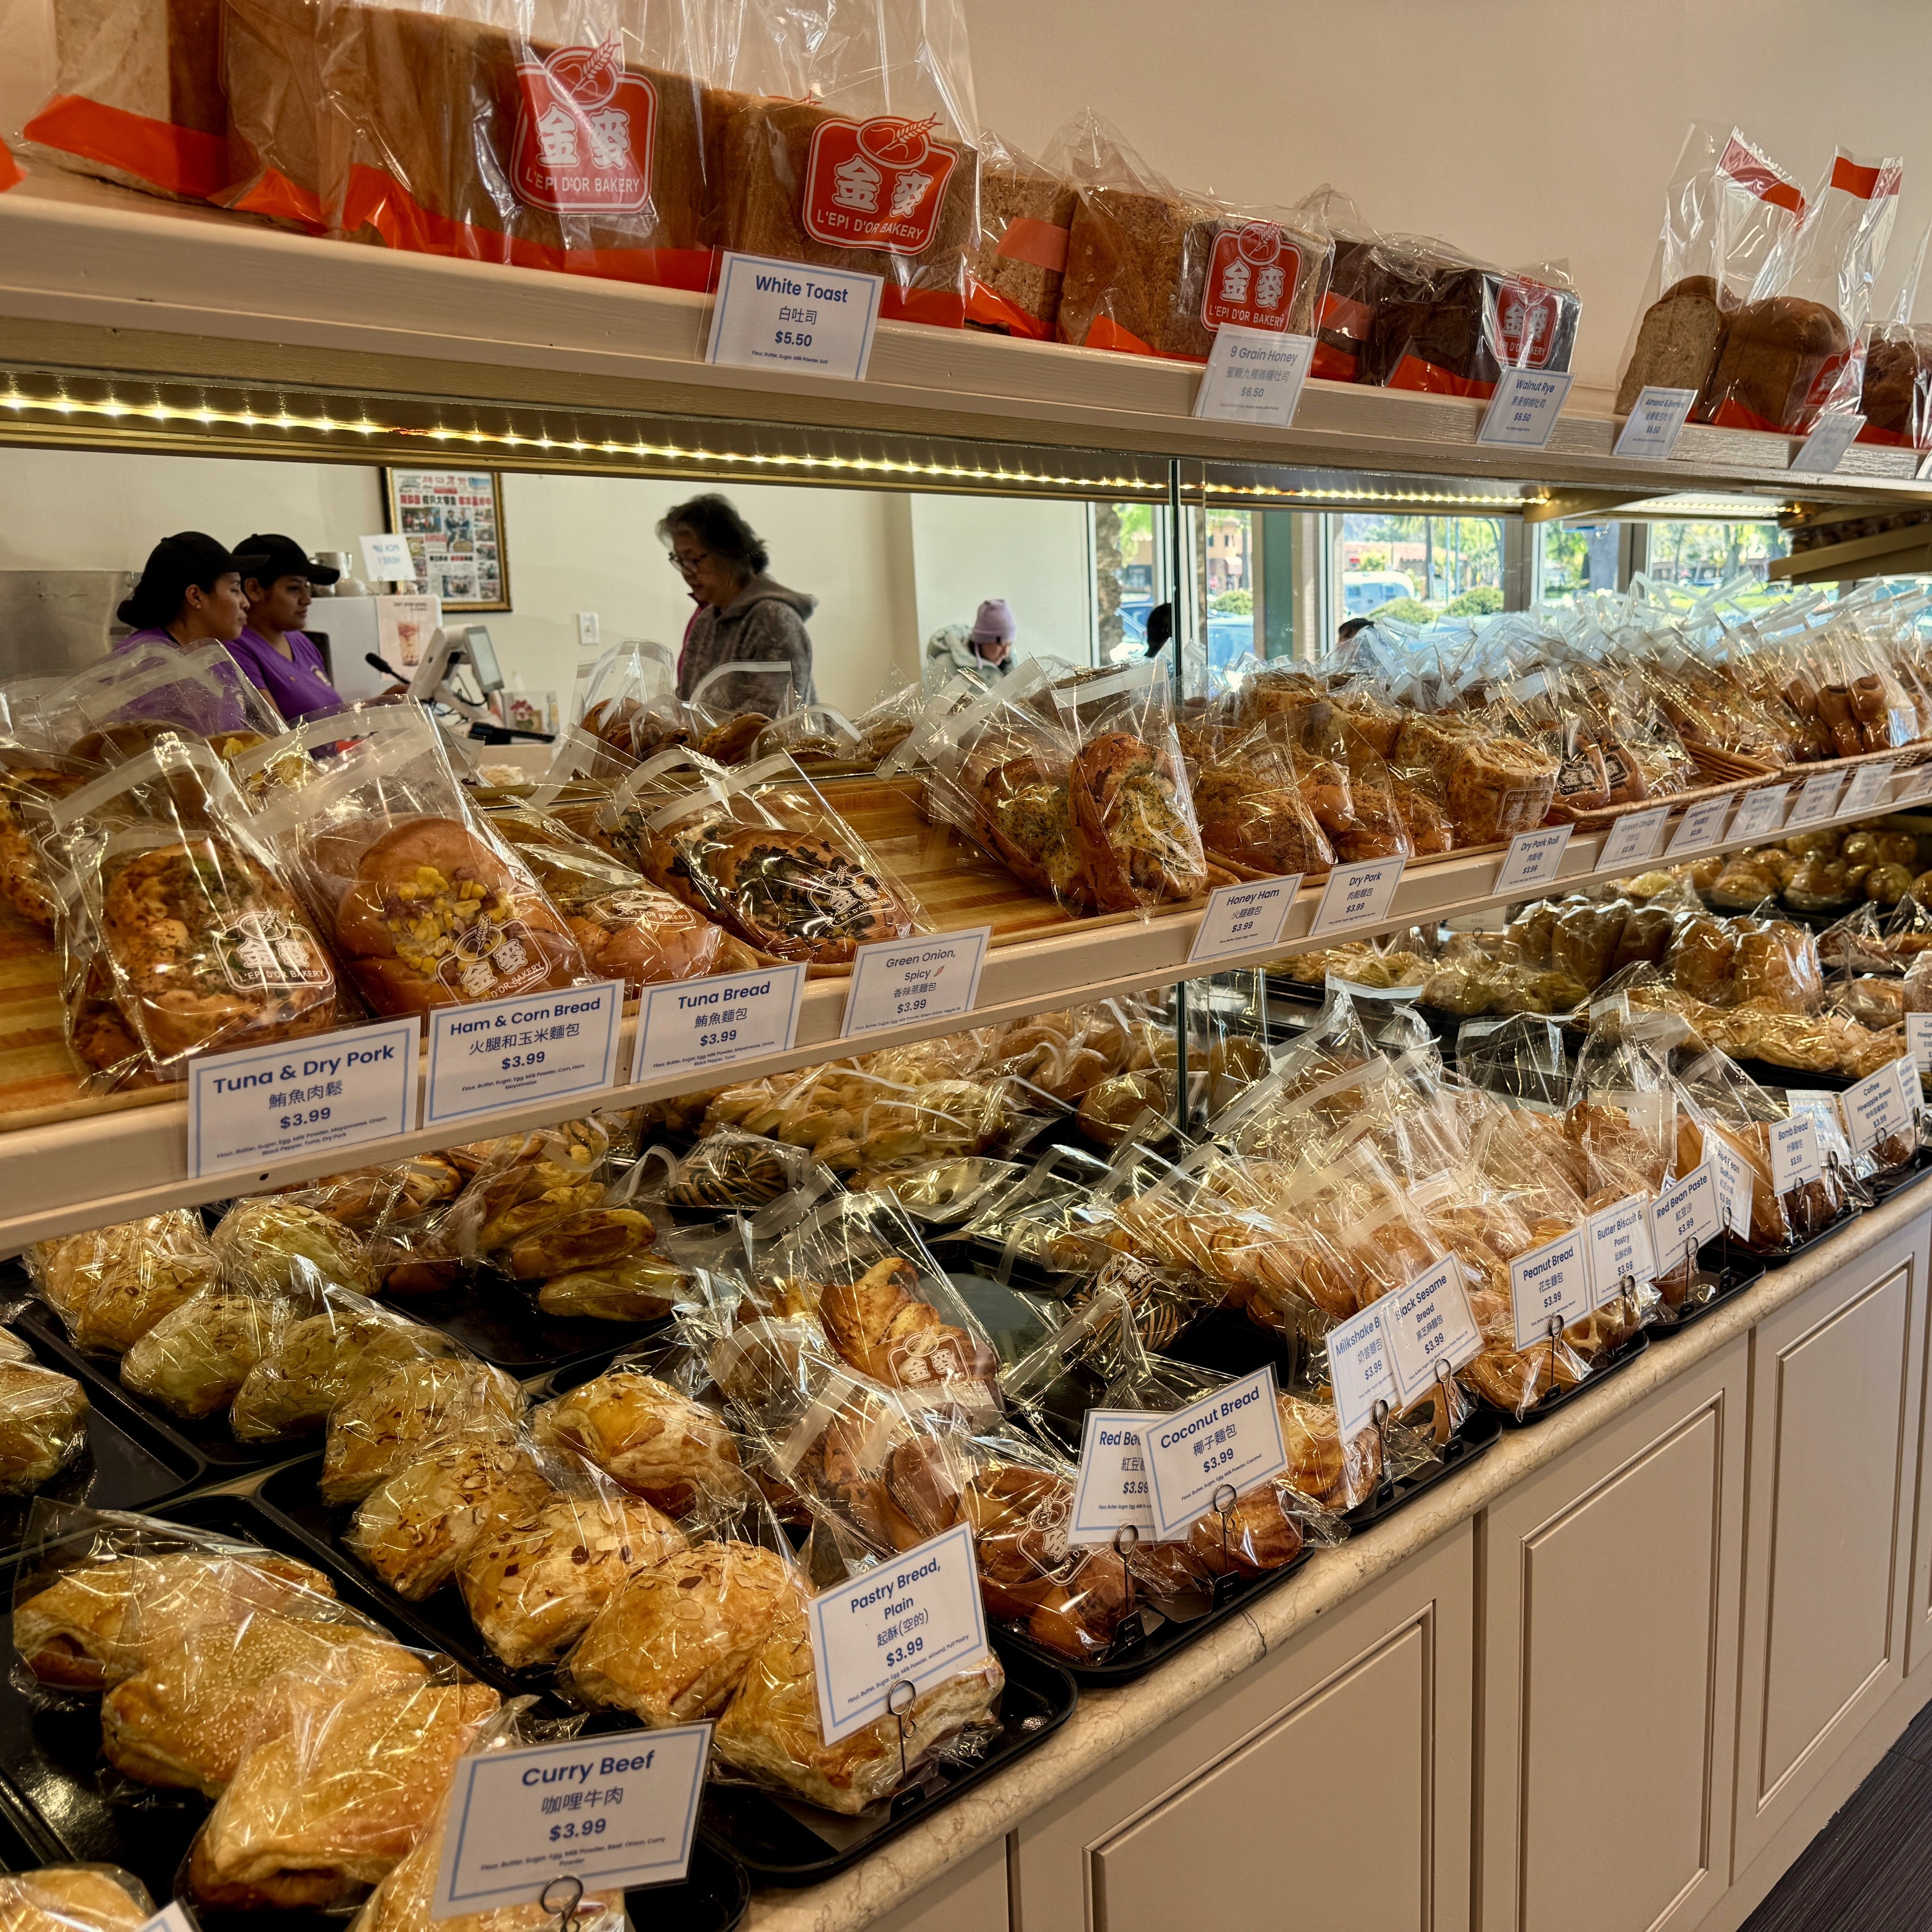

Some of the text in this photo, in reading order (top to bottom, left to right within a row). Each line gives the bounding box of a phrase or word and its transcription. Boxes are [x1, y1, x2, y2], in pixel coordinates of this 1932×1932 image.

[525, 167, 639, 193] L'EPI D'OR BAKERY
[817, 210, 924, 239] L'EPI D'OR BAKERY
[756, 275, 848, 303] White Toast
[779, 306, 817, 325] 白吐司
[1209, 304, 1284, 327] L'EPI D'OR BAKERY
[775, 331, 812, 346] $5.50
[1230, 346, 1298, 366] 9 Grain Honey
[1241, 386, 1264, 397] $6.50
[1516, 380, 1555, 395] Walnut Rye
[1514, 412, 1531, 422] $6.50
[1622, 819, 1655, 832] Green Onion
[1521, 836, 1560, 852] Dry Pork Roll
[1349, 871, 1382, 887] Dry Pork
[1523, 865, 1537, 874] $3.99
[1227, 889, 1279, 906] Honey Ham
[1346, 902, 1365, 913] $3.99
[835, 903, 869, 924] L'EPI D'OR
[1232, 921, 1253, 933] $3.99
[886, 949, 956, 967] Green Onion,
[291, 970, 324, 978] BAKERY
[490, 961, 543, 998] D'OR BAKERY
[905, 969, 931, 982] Spicy
[678, 981, 770, 1009] Tuna Bread
[451, 998, 600, 1035] Ham & Corn Bread
[897, 999, 926, 1014] $3.99
[694, 1007, 747, 1028] 鮪魚麵包
[469, 1023, 580, 1055] 火腿和玉米麵包
[700, 1030, 737, 1047] $3.99
[213, 1045, 395, 1094] Tuna & Dry Pork
[501, 1051, 545, 1070] $3.99
[268, 1080, 343, 1109] 鮪魚肉鬆
[1863, 1082, 1880, 1096] Coffee
[1857, 1086, 1891, 1113] Pineapple Bread
[280, 1107, 331, 1129] $3.99
[1873, 1114, 1886, 1128] $3.99
[1778, 1122, 1808, 1141] Bomb Bread
[1718, 1150, 1727, 1163] Red
[1790, 1155, 1802, 1166] $3.99
[1657, 1175, 1707, 1219] Red Bean Paste
[1720, 1193, 1731, 1207] $3.99
[1597, 1210, 1642, 1240] Butter Biscuit &
[1678, 1218, 1693, 1235] $3.99
[1614, 1234, 1629, 1247] Pastry
[1523, 1246, 1573, 1281] Peanut Bread
[1618, 1261, 1633, 1276] $3.99
[1538, 1272, 1564, 1293] 花生麵包
[1395, 1275, 1447, 1321] Black Sesame
[1544, 1291, 1562, 1308] $3.99
[1416, 1303, 1435, 1323] Bread
[1335, 1321, 1374, 1357] Milkshake
[1425, 1333, 1444, 1354] $3.99
[1365, 1360, 1382, 1380] $3.99
[924, 1379, 939, 1388] D'OR
[1160, 1386, 1260, 1448] Coconut Bread
[1099, 1431, 1122, 1445] Red
[1193, 1424, 1237, 1456] 椰子麵包
[1204, 1448, 1234, 1473] $3.99
[1123, 1481, 1149, 1495] $3.99
[851, 1557, 941, 1613] Pastry Bread,
[884, 1596, 914, 1620] Plain
[876, 1608, 929, 1647] 起酥(空的)
[886, 1637, 924, 1667] $3.99
[522, 1749, 655, 1786] Curry Beef
[541, 1786, 623, 1815] 咖哩牛肉
[549, 1818, 607, 1842] $3.99
[647, 1836, 666, 1845] Curry
